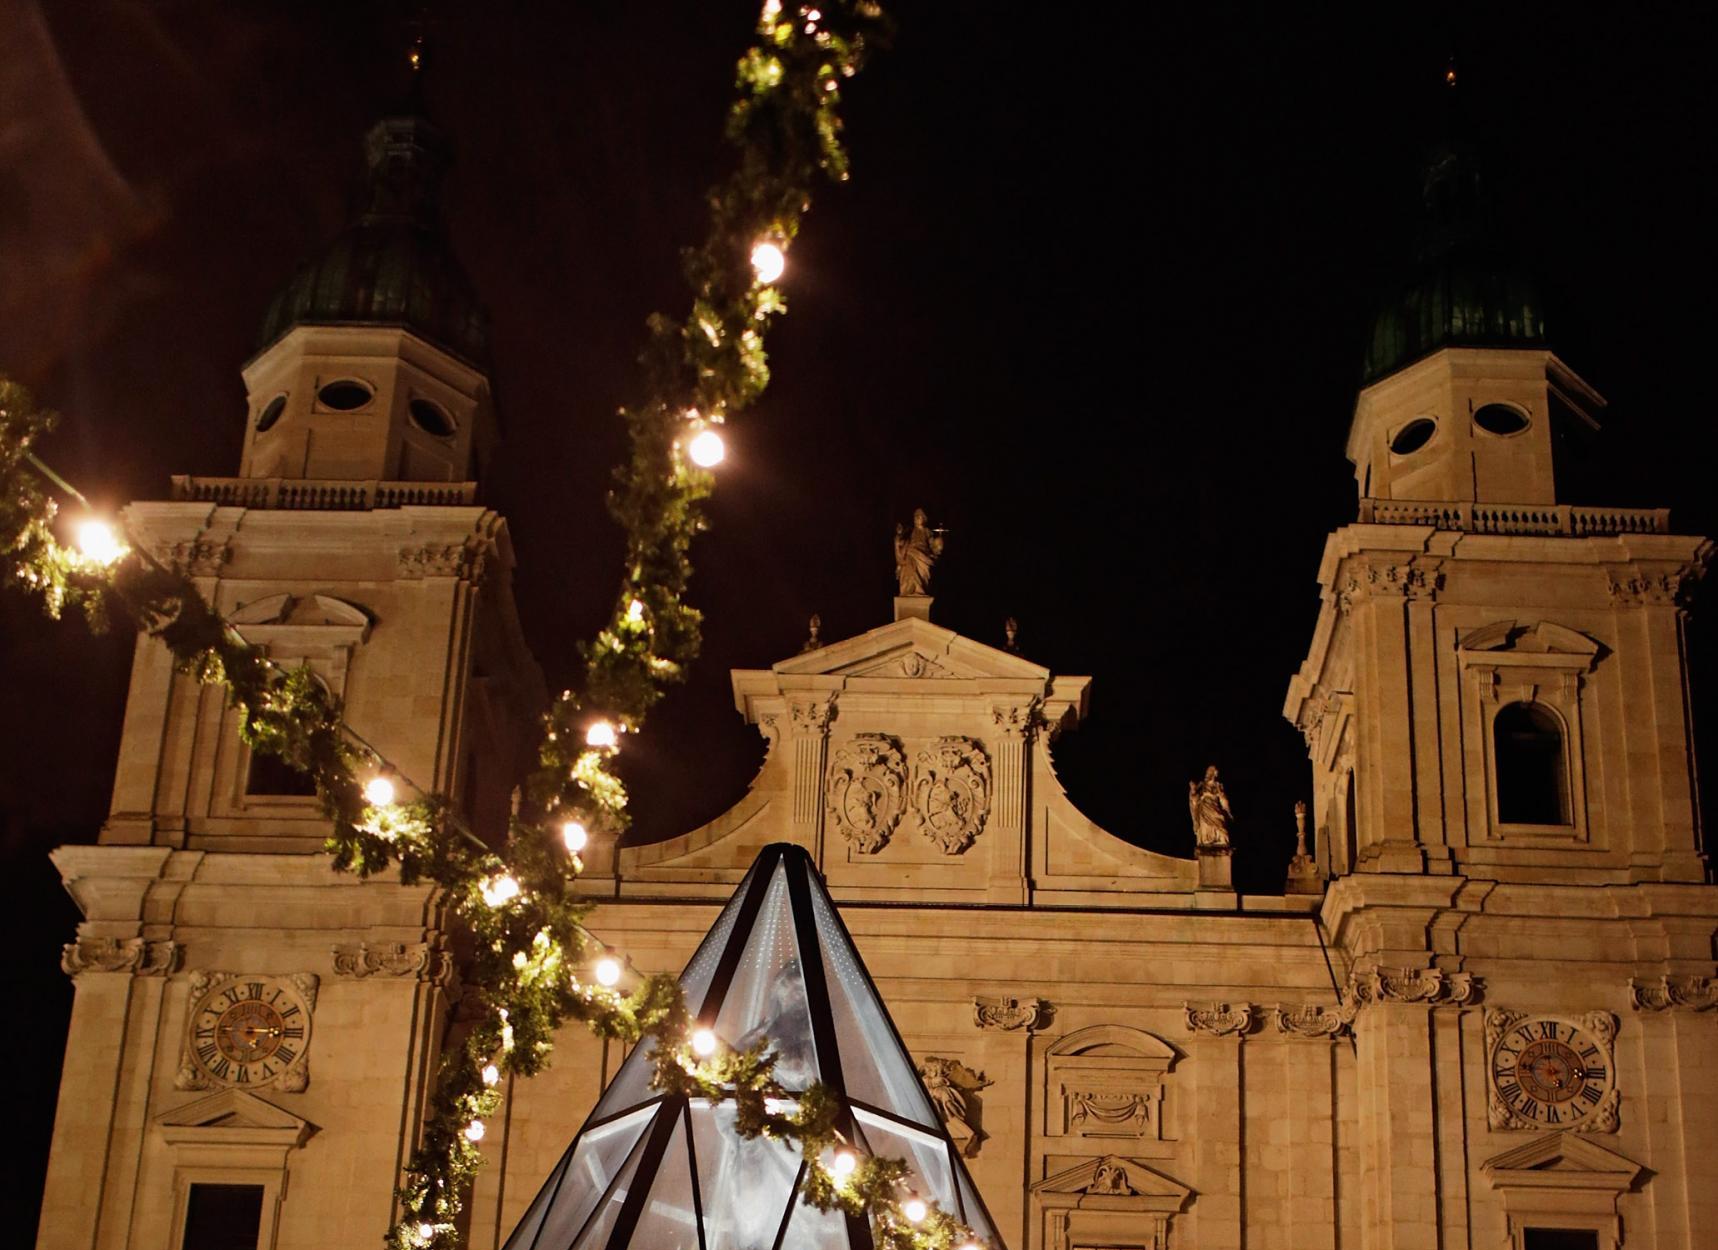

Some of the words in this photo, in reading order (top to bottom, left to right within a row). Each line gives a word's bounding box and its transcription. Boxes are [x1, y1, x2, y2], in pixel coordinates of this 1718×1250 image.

[244, 983, 266, 1000] XII
[1514, 1024, 1536, 1042] XI
[1537, 1021, 1560, 1040] XII
[1566, 1026, 1579, 1044] I
[1500, 1042, 1521, 1056] X
[1578, 1043, 1600, 1058] II
[1586, 1065, 1606, 1082] III
[1544, 1103, 1562, 1124] VI
[1570, 1102, 1588, 1120] V
